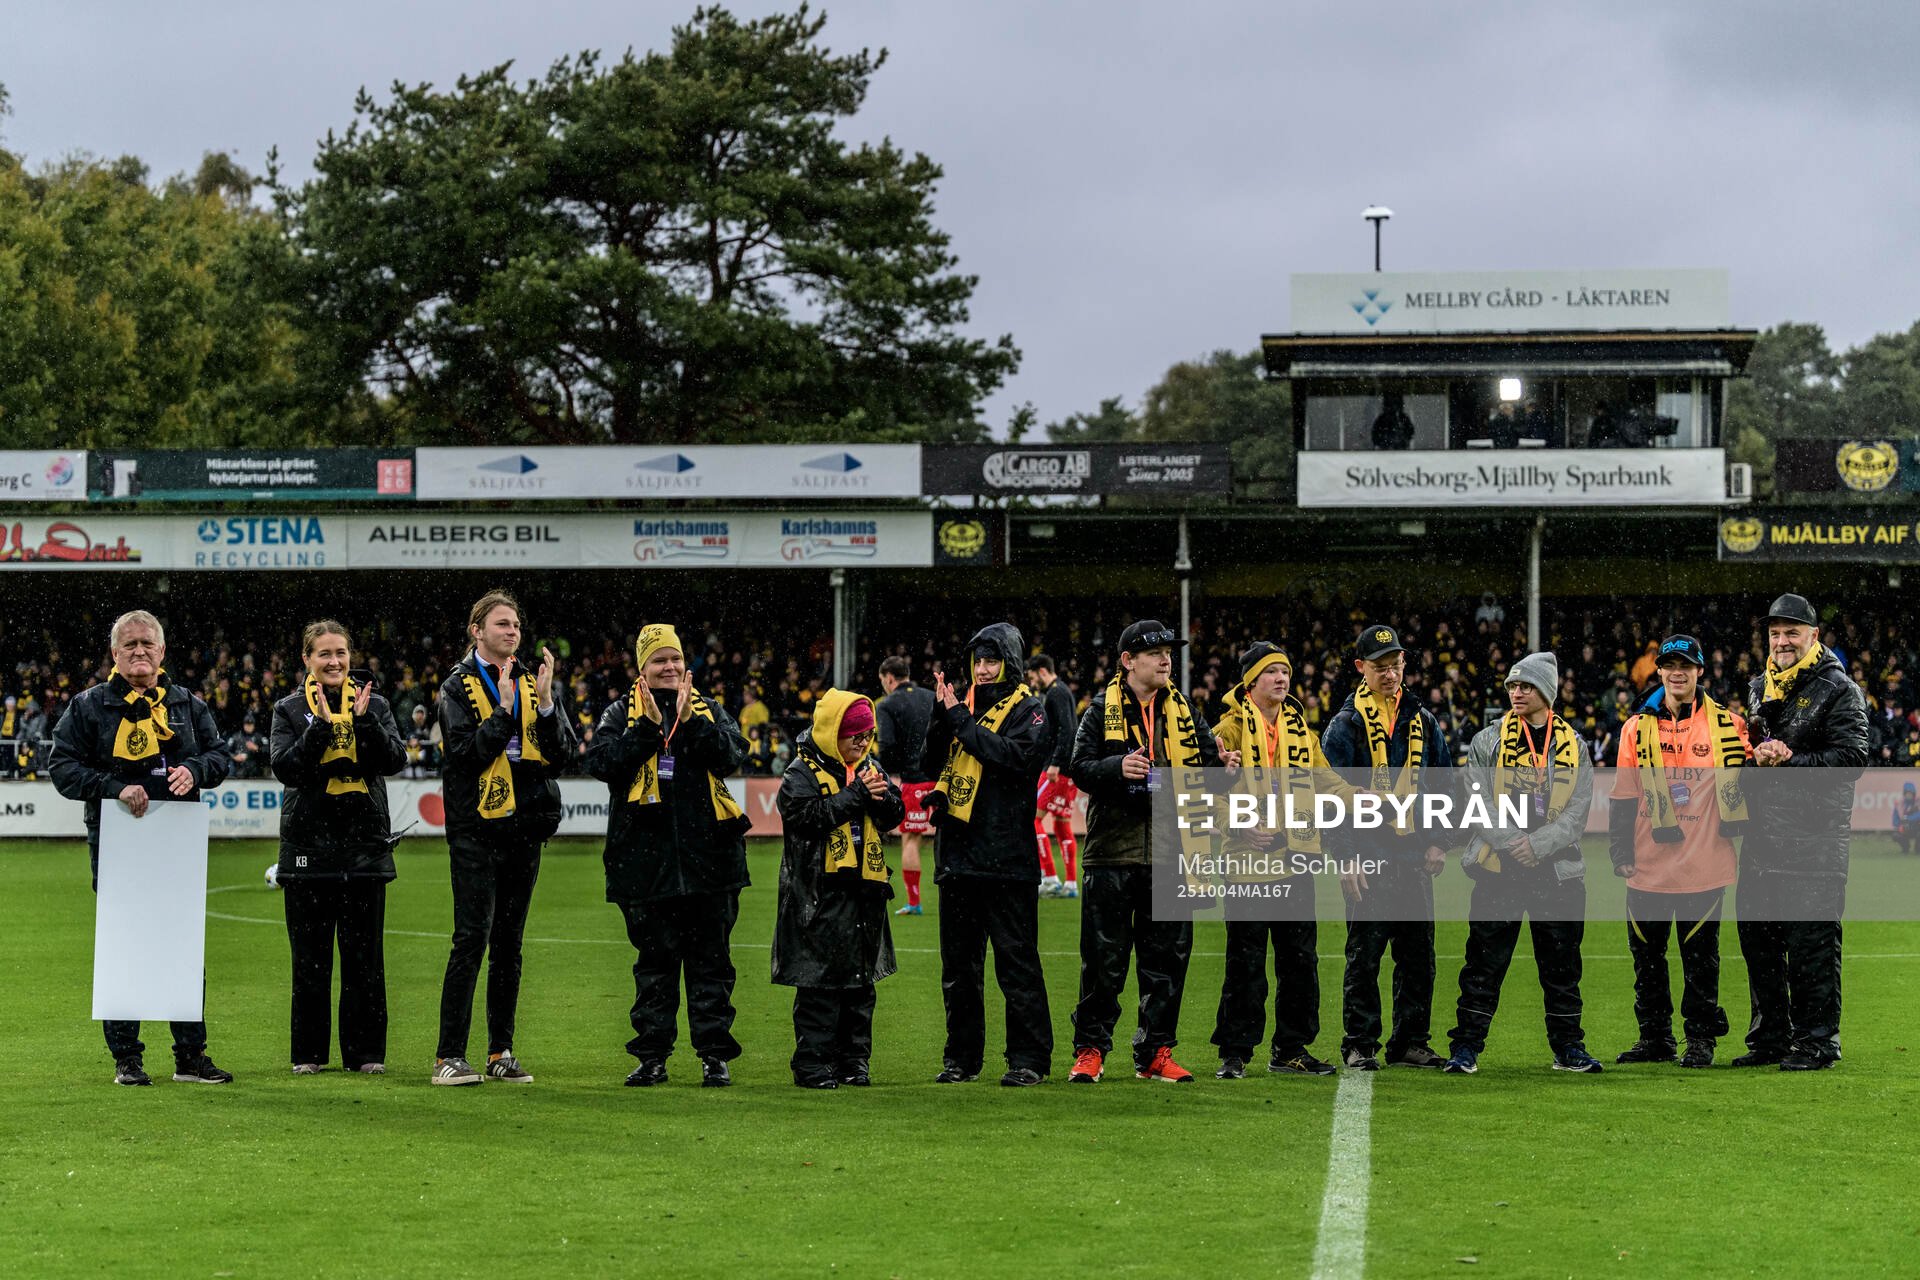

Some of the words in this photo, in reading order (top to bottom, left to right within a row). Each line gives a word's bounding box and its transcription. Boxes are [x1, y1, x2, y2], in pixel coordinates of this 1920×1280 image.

[1405, 290, 1481, 309] MELLBY
[1486, 287, 1543, 308] GÅRD
[1566, 286, 1671, 306] LÄKTAREN
[1064, 454, 1087, 475] AB
[1119, 455, 1201, 466] LISTERLANDET
[0, 475, 19, 491] rg
[22, 473, 32, 487] C
[1126, 467, 1161, 483] Since
[1345, 464, 1558, 493] Sölvesborg-Mjällby
[1565, 463, 1673, 493] Sparbank
[227, 517, 325, 544] STENA
[369, 525, 509, 543] AHLBERG
[514, 525, 560, 543] BIL
[633, 519, 729, 536] Karlshamns
[781, 518, 877, 536] Karlshamns
[1770, 521, 1869, 545] MJÄLLBY
[1873, 524, 1909, 545] AIF
[195, 551, 326, 567] RECYCLING
[296, 856, 308, 868] KB
